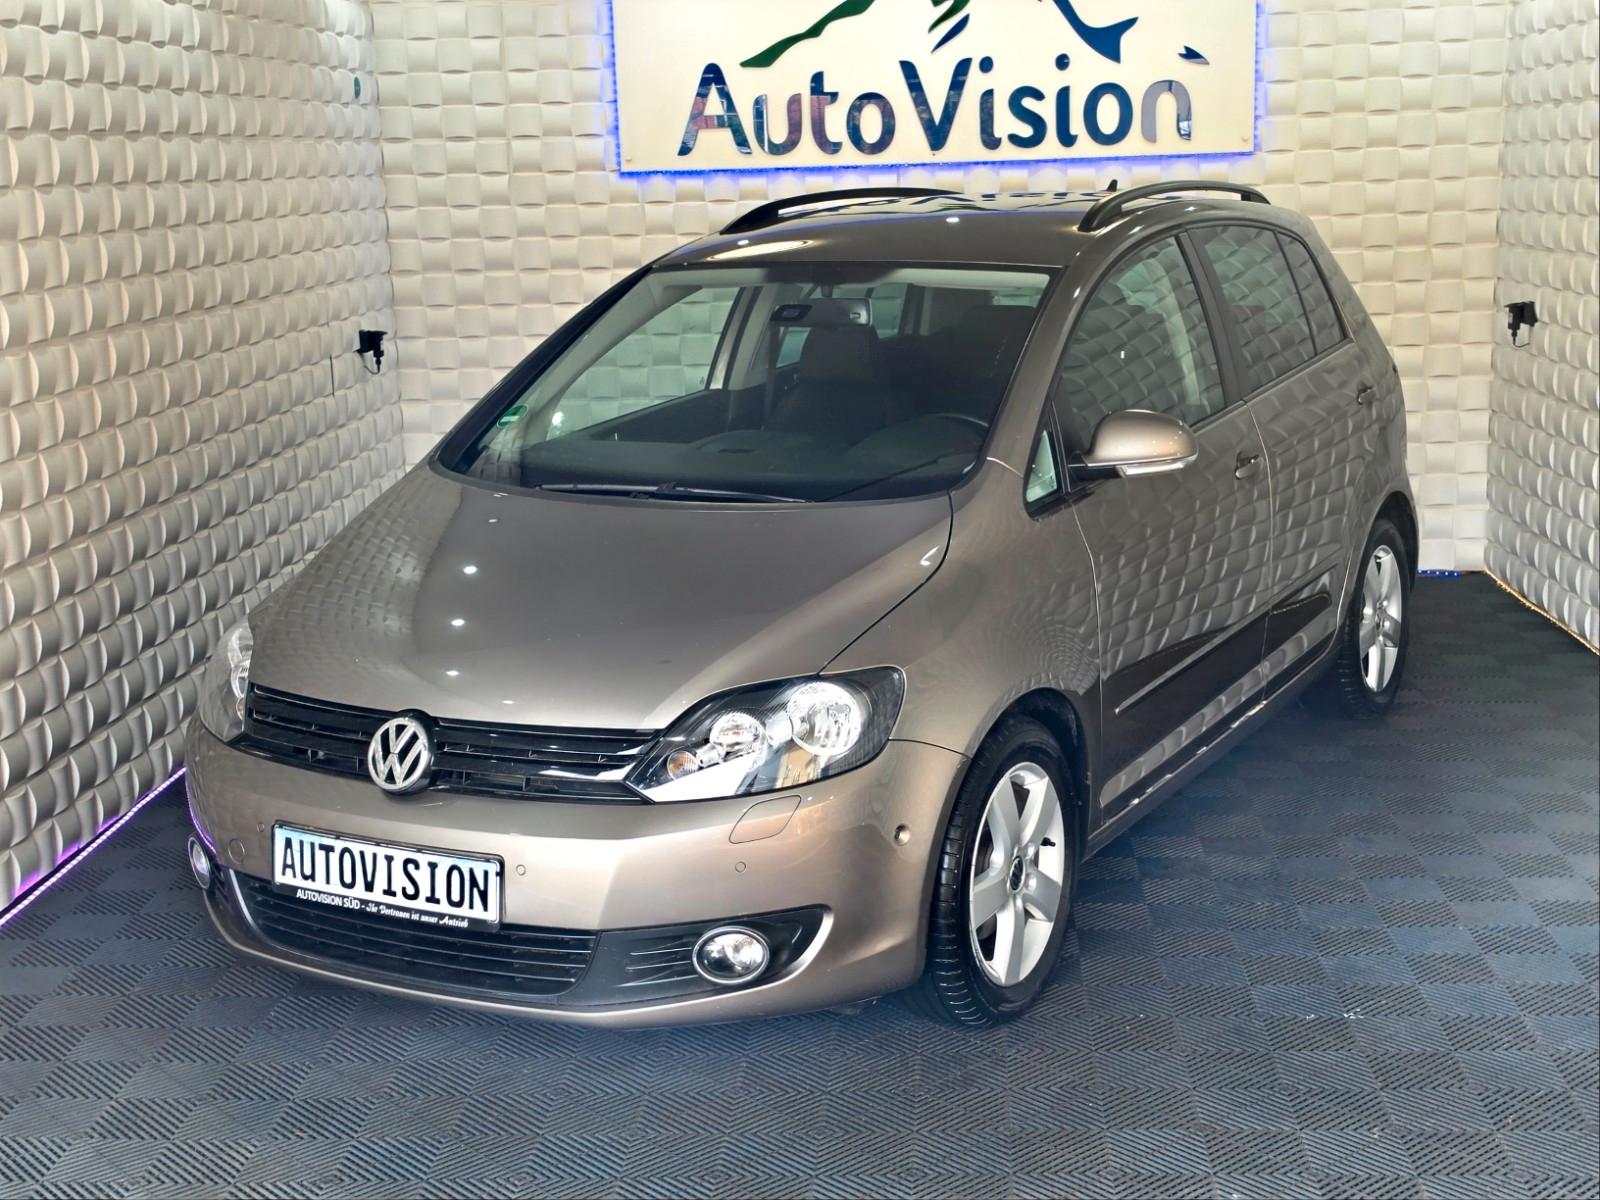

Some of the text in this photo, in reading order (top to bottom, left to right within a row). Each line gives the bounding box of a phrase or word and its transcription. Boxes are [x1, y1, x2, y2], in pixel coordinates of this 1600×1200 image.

[677, 52, 1193, 156] AutoVision
[281, 836, 489, 913] AUTOVISION
[296, 888, 342, 907] AUTOVISION
[343, 896, 360, 910] SÜD
[411, 911, 420, 921] ist
